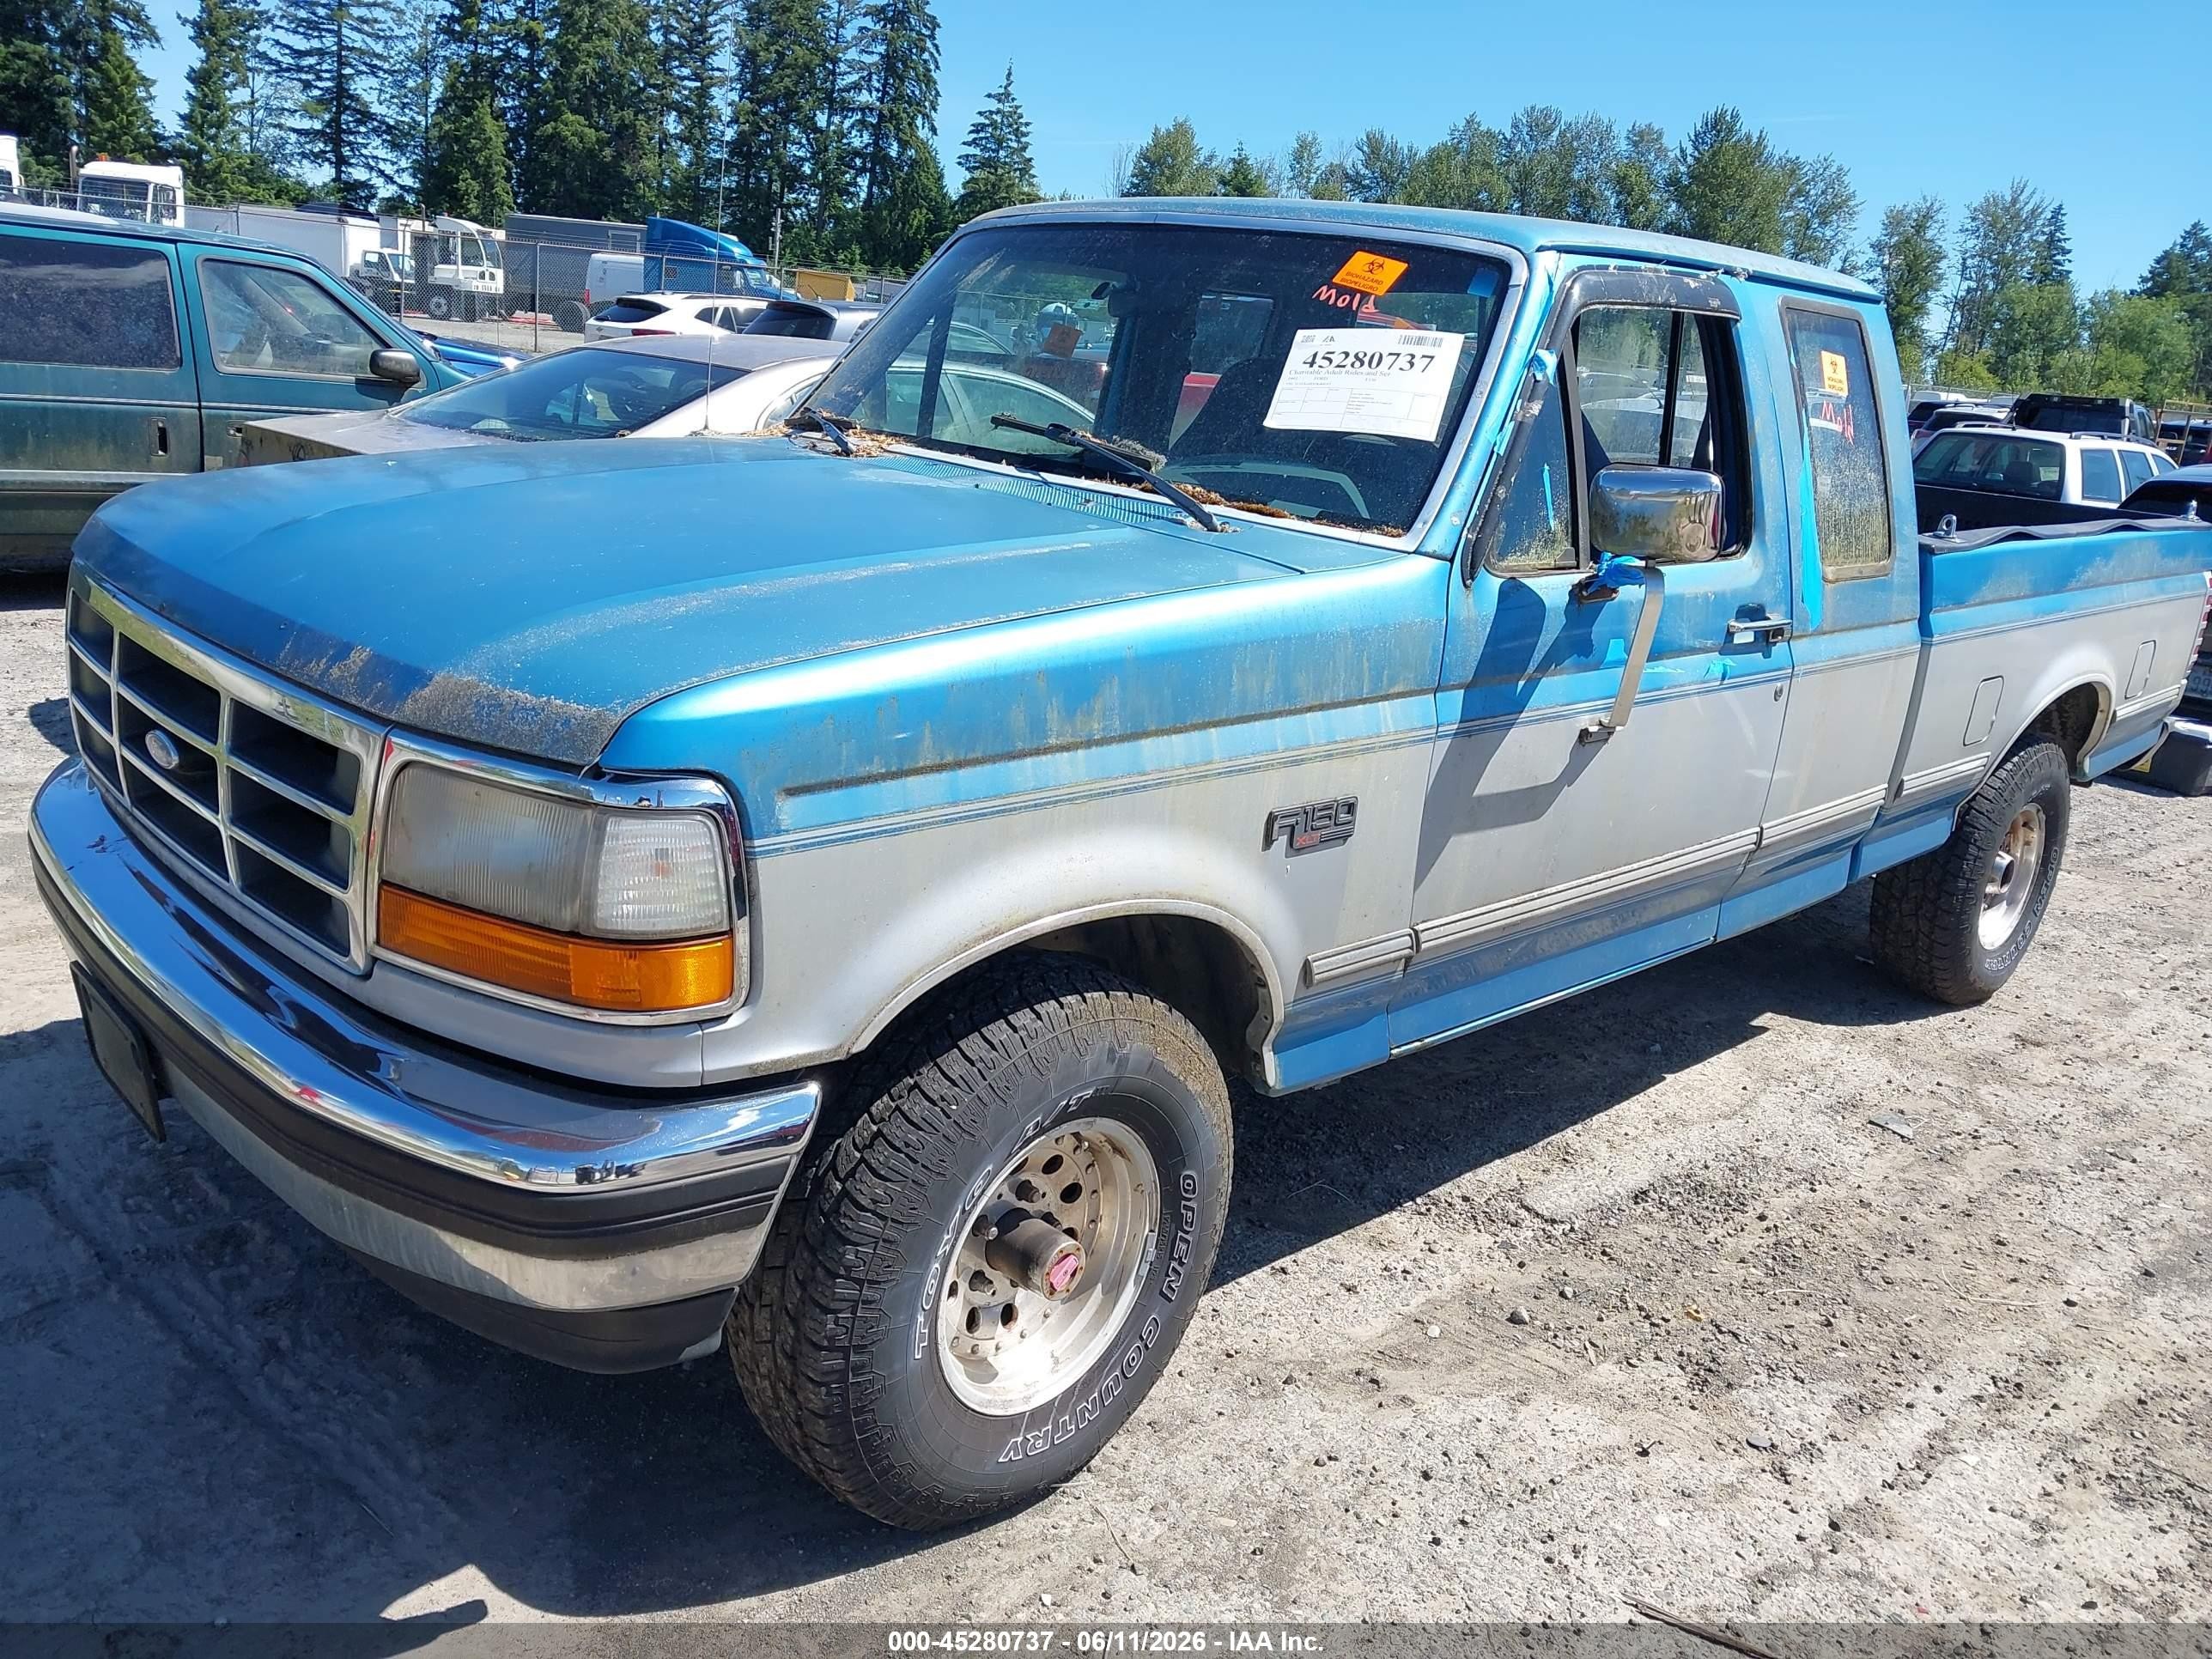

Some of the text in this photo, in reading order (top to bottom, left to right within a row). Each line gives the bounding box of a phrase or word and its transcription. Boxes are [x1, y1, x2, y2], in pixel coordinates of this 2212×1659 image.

[1340, 277, 1378, 291] BIOPELIGRO
[1346, 271, 1383, 285] BIOHAZARD
[1302, 350, 1436, 373] 45280737
[915, 1165, 993, 1360] TOYO
[997, 1170, 1200, 1463] OPEN COUNTRY
